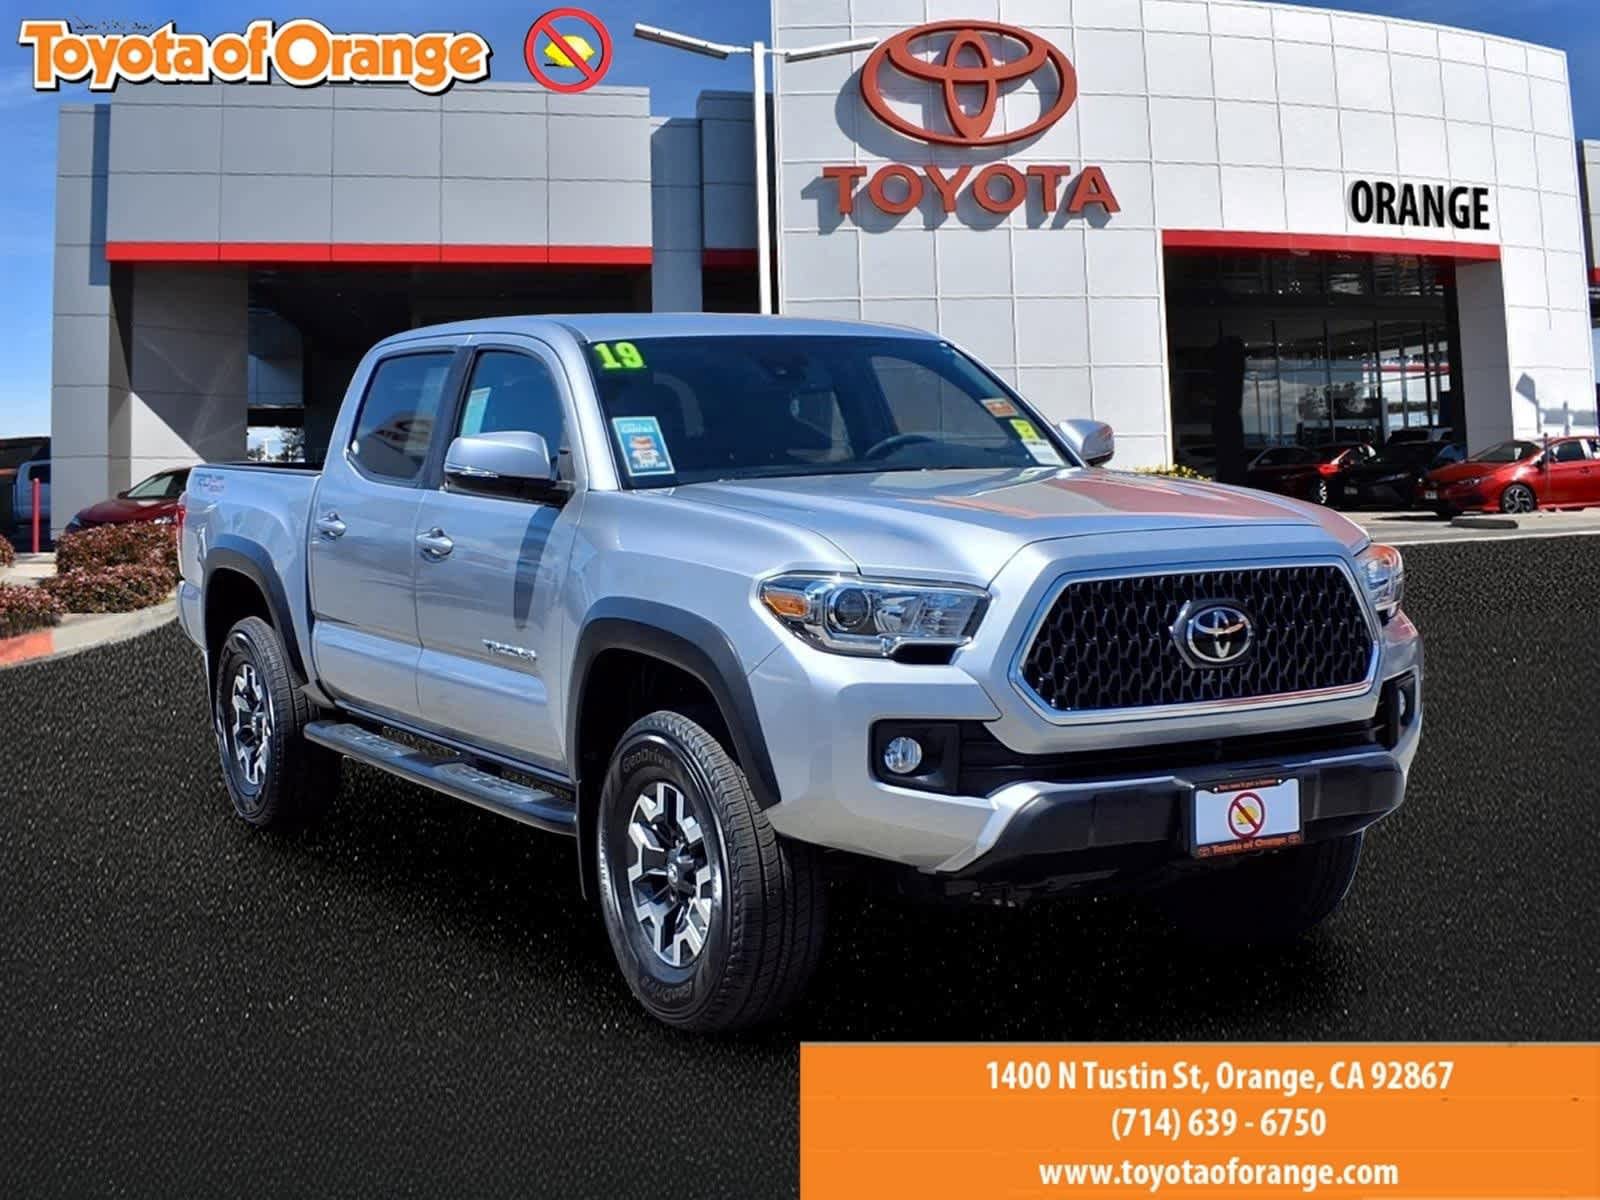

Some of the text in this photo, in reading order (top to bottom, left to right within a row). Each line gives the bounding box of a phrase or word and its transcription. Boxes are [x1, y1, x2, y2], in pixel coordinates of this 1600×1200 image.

[824, 164, 1119, 214] TOYOTA
[1350, 180, 1490, 230] ORANGE
[594, 342, 644, 369] 19
